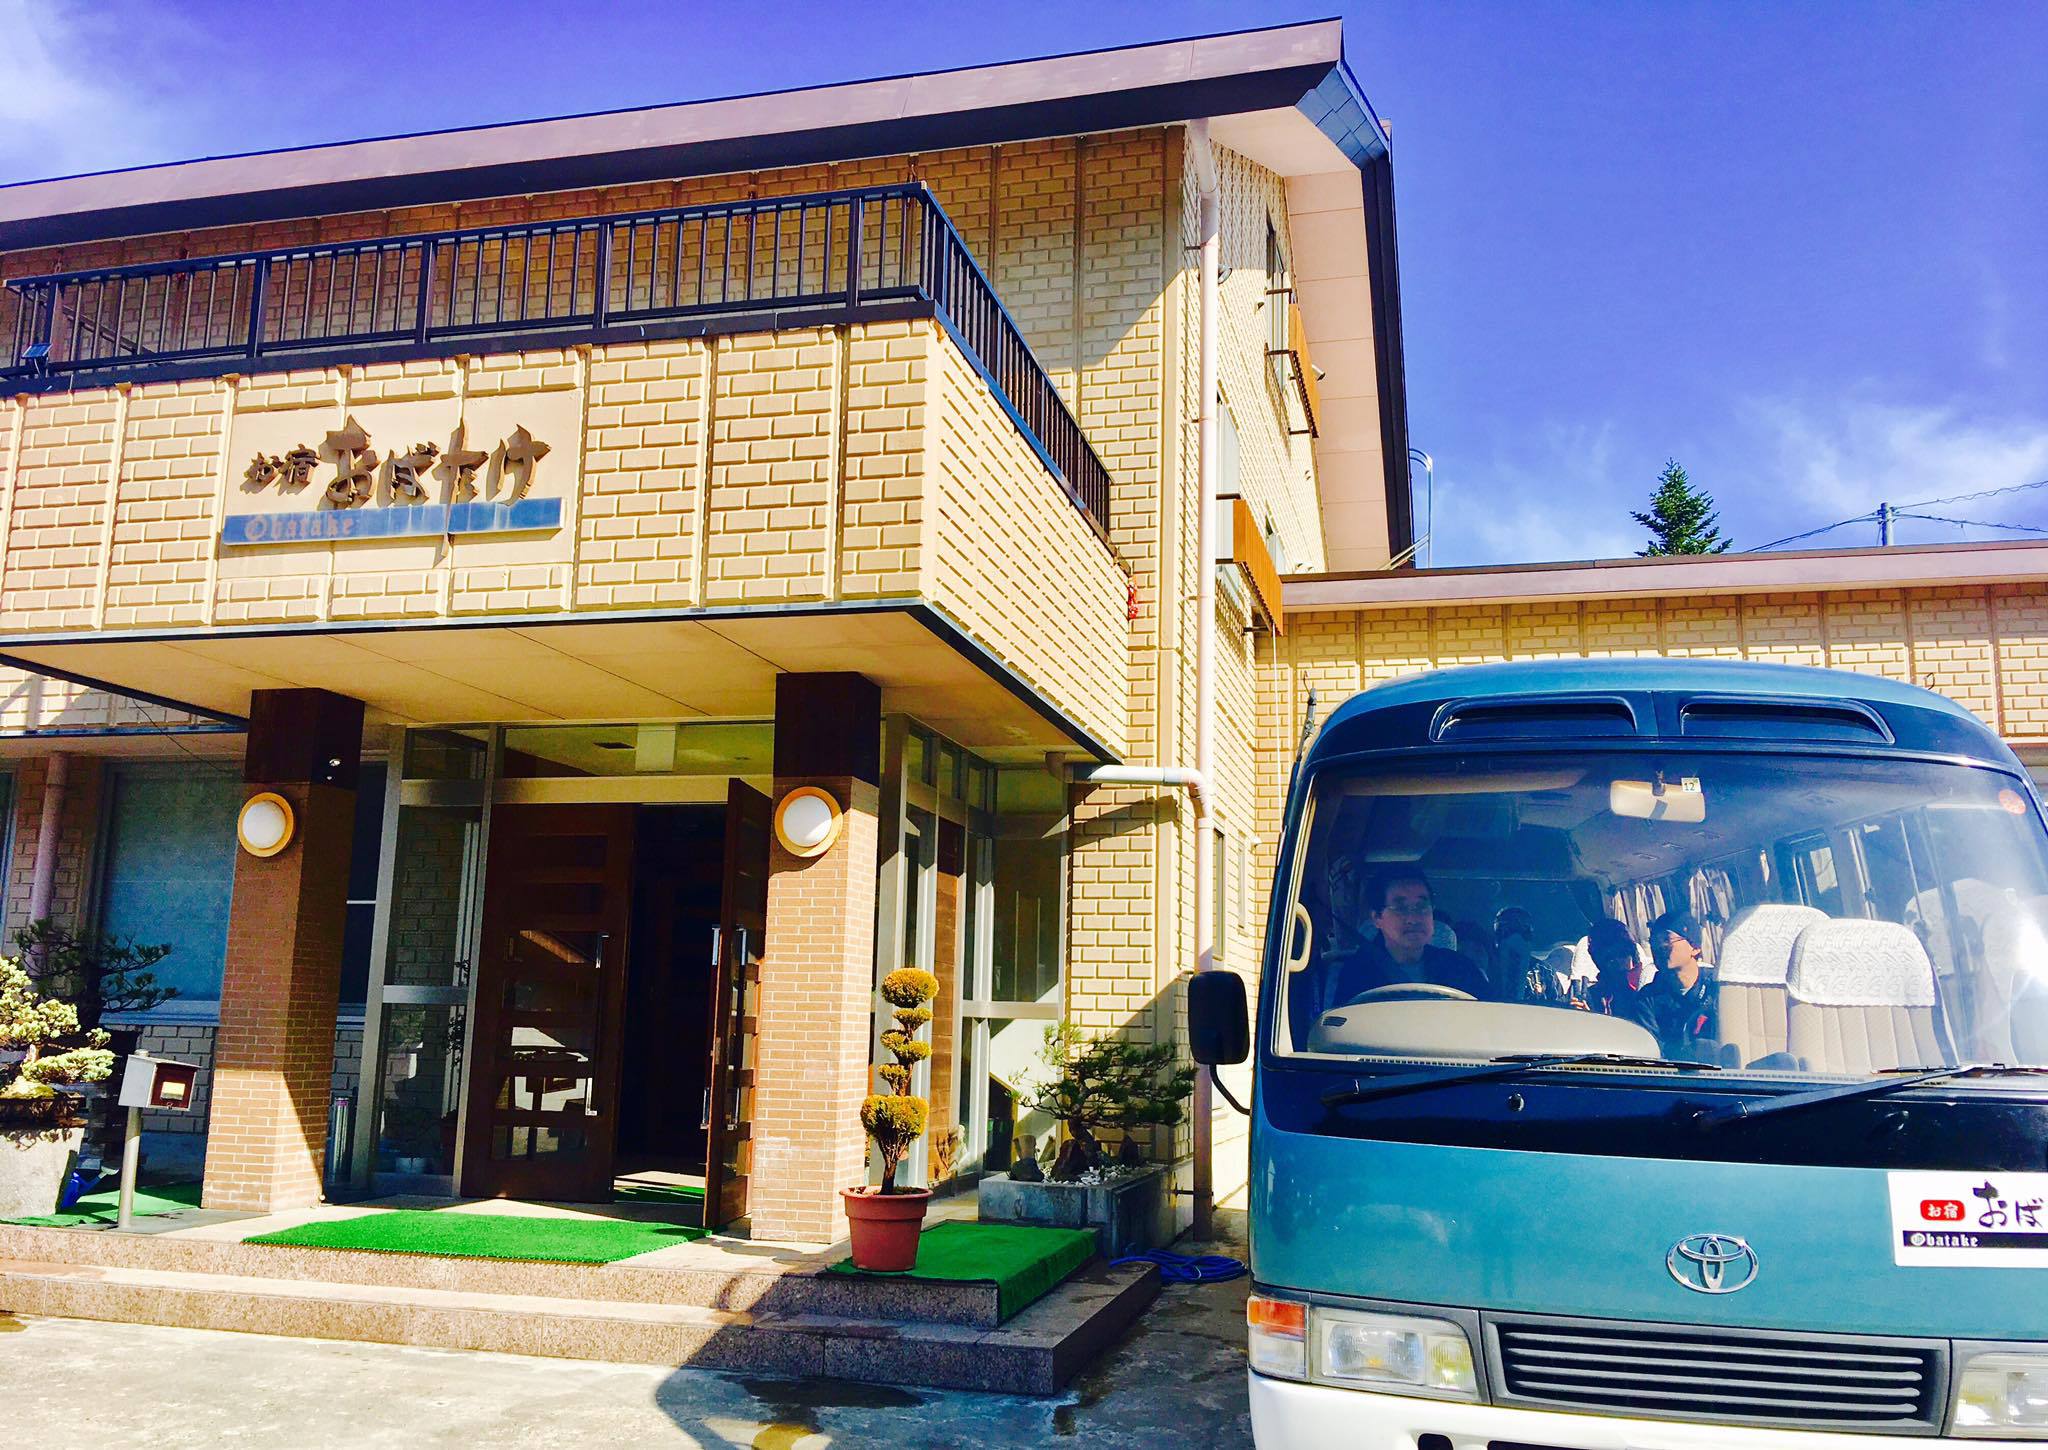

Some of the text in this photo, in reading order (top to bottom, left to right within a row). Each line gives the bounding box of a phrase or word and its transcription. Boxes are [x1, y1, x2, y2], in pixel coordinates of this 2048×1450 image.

[321, 414, 551, 528] おばたけ
[244, 512, 354, 541] Obatake
[1928, 1180, 2044, 1229] お宿 おば
[1910, 1232, 1979, 1247] Obatake
